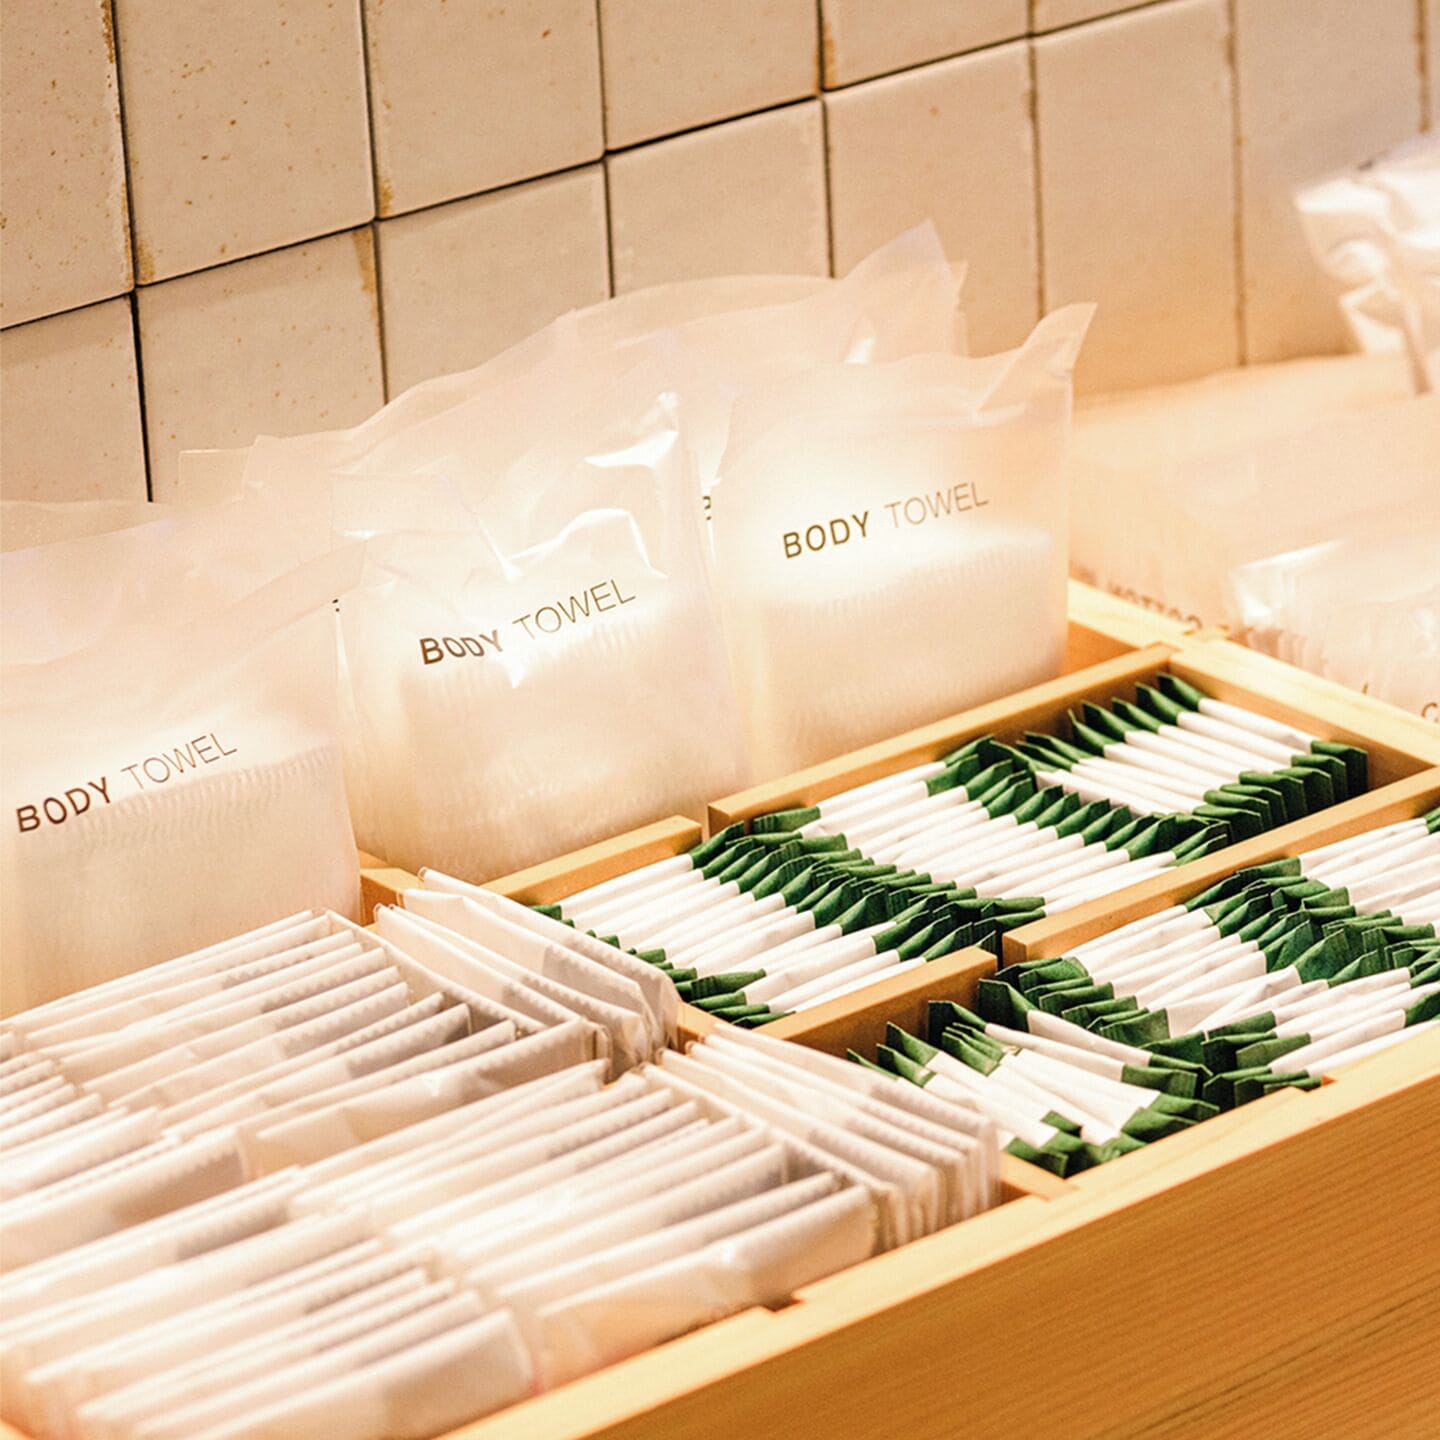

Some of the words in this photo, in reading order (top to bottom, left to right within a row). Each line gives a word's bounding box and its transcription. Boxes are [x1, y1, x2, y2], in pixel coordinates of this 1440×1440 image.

[782, 510, 870, 559] BODY
[883, 481, 990, 529] TOWEL
[419, 629, 503, 665] BODY
[511, 579, 637, 640] TOWEL
[15, 775, 111, 833] BODY
[120, 732, 238, 790] TOWEL
